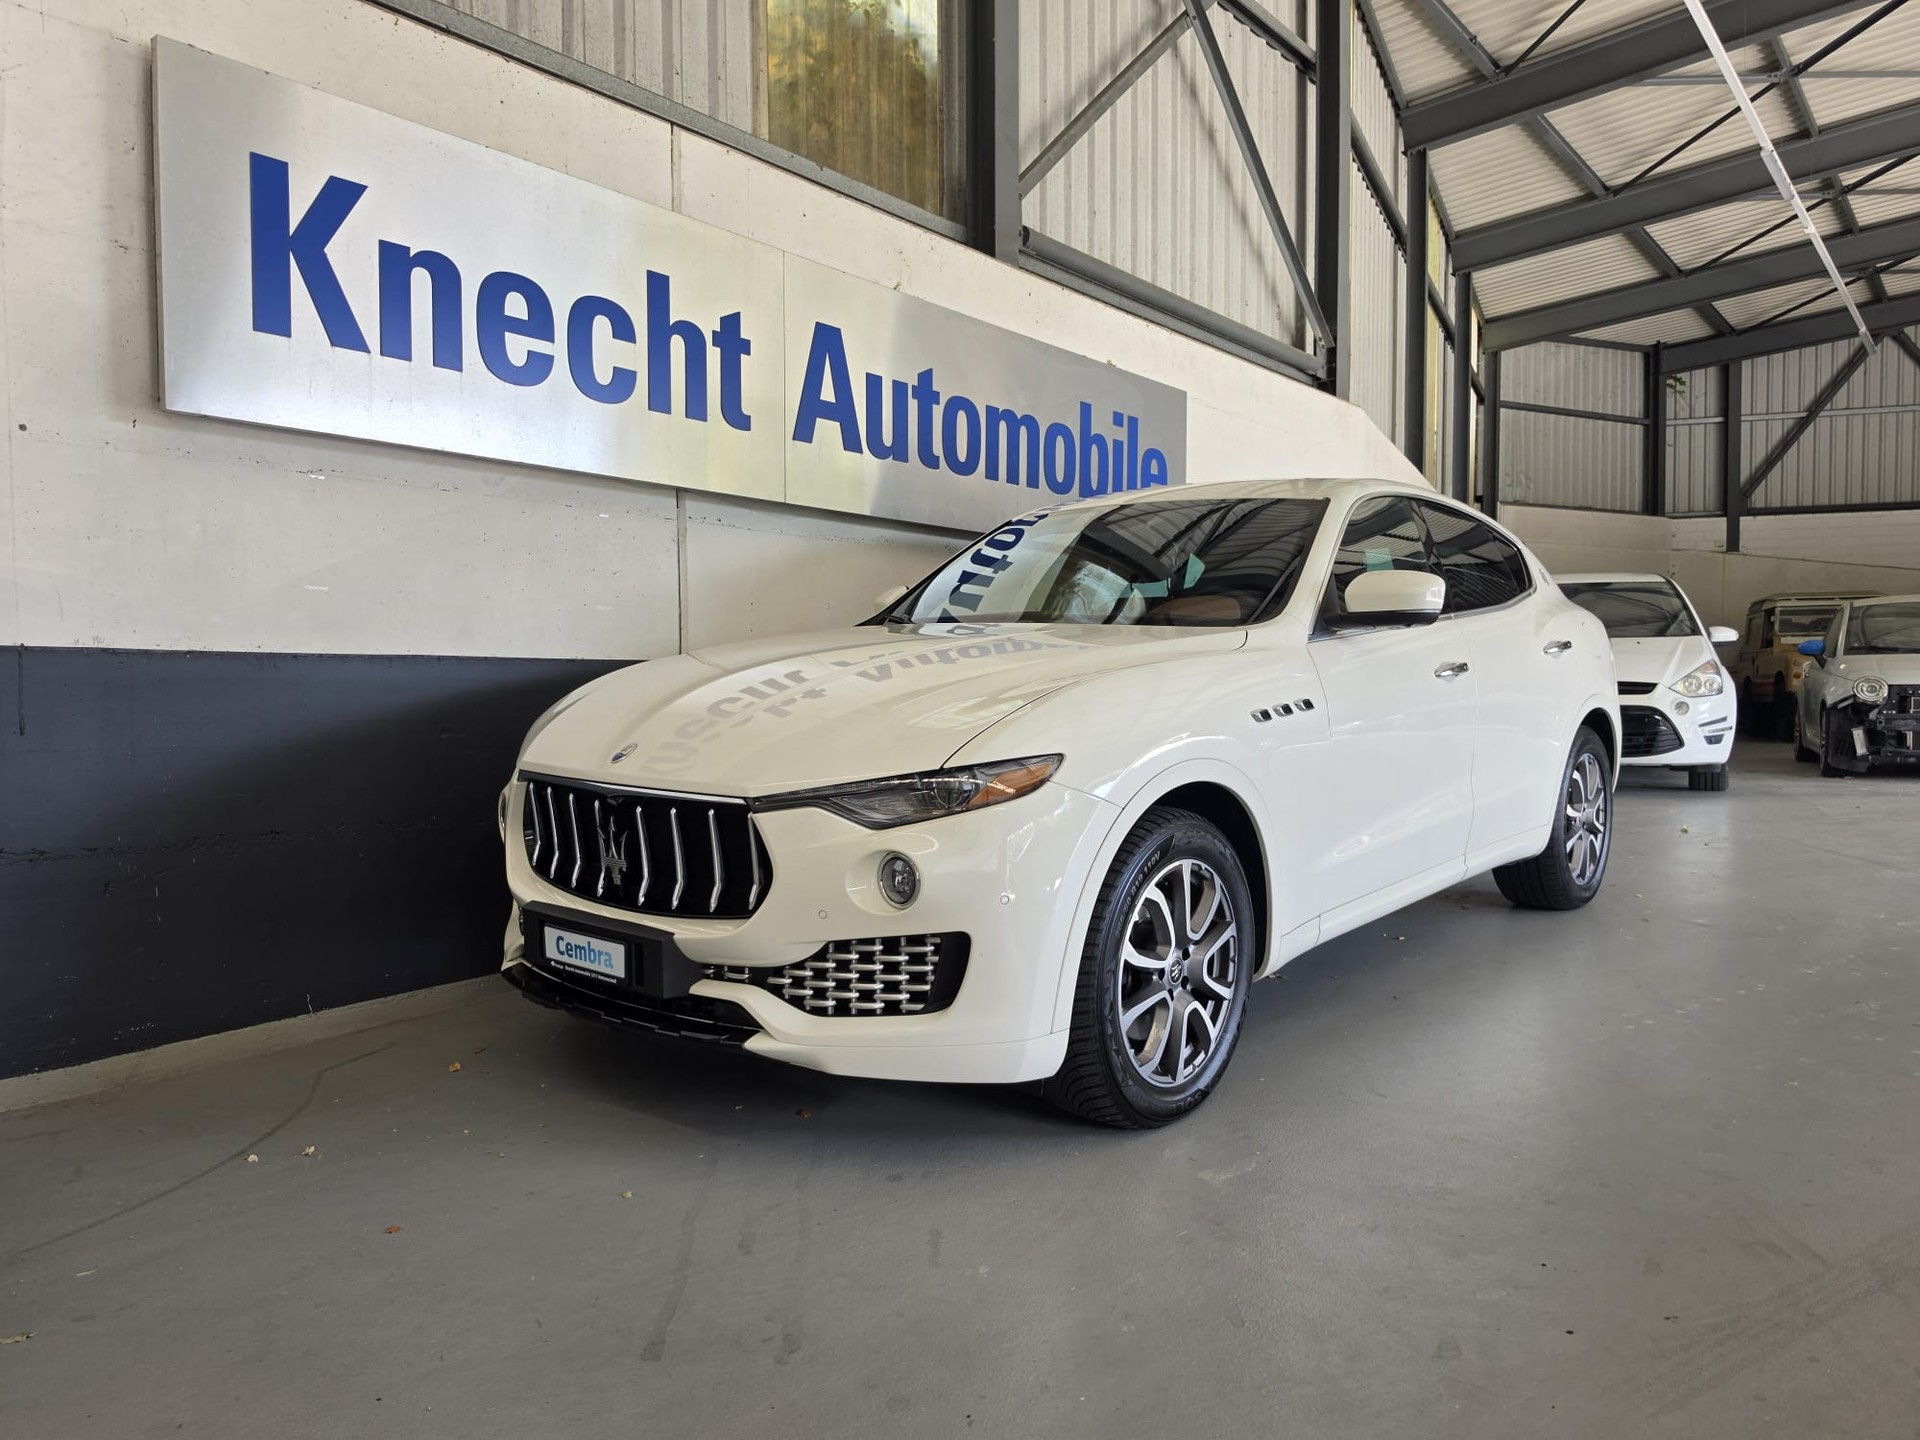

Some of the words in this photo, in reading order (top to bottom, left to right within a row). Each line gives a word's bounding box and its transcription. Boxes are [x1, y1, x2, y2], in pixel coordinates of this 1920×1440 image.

[251, 153, 751, 431] Knecht
[793, 322, 1169, 499] Automobile
[555, 935, 614, 970] Cembra
